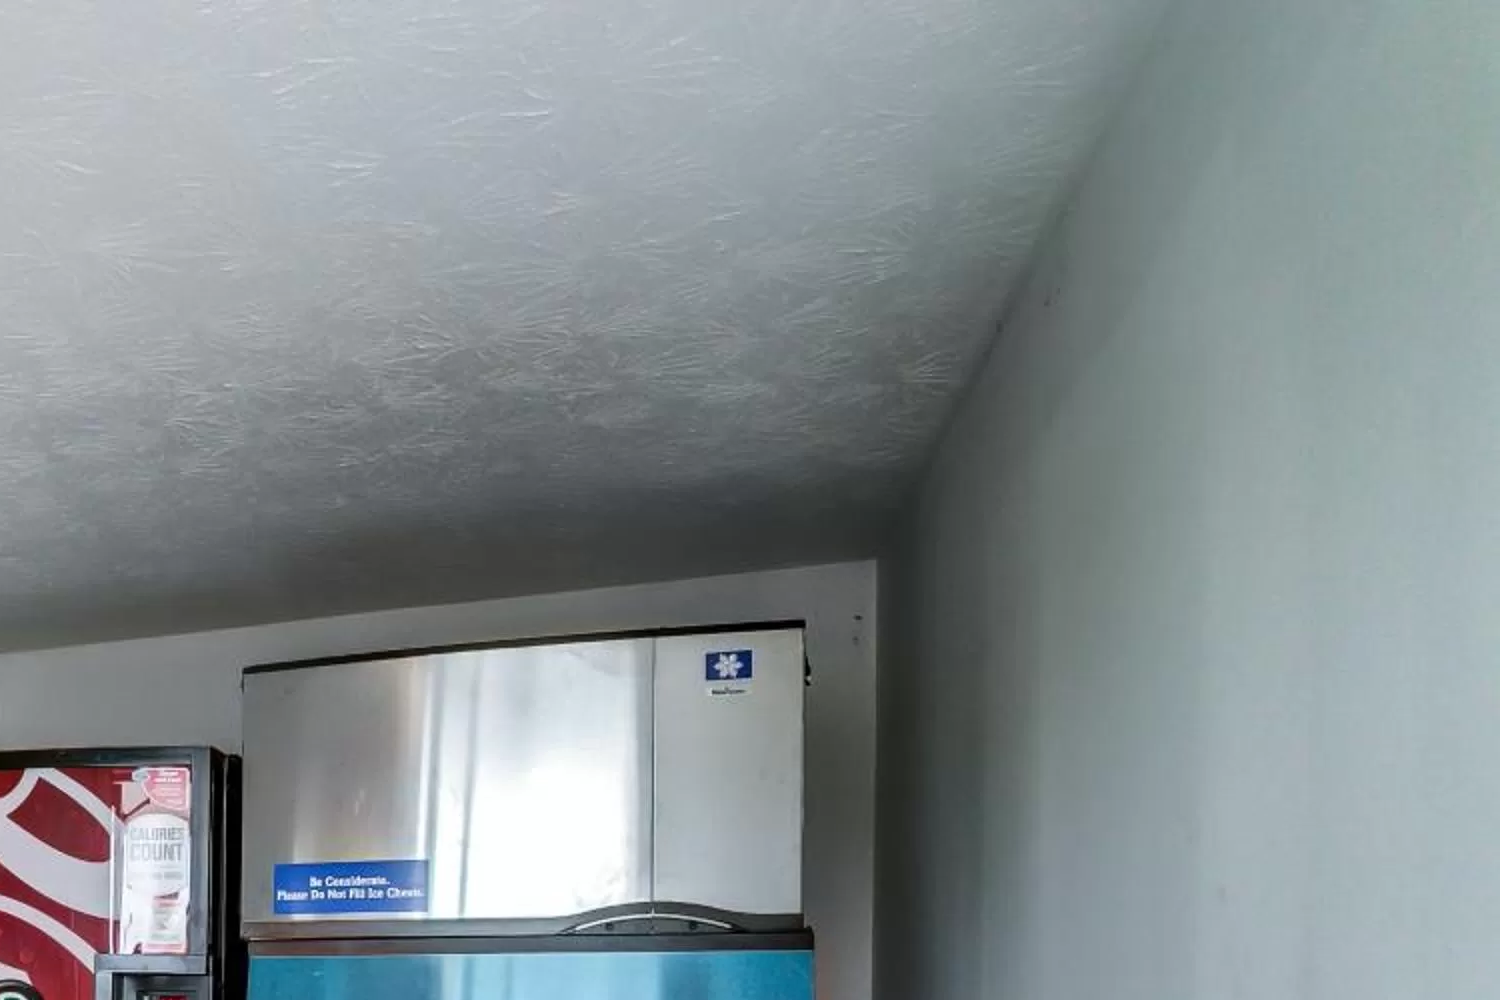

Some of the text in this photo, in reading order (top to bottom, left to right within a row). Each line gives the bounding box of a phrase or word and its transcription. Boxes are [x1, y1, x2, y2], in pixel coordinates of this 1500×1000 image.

[130, 842, 183, 862] COUNT
[311, 889, 325, 900] Do
[327, 888, 347, 899] Not
[368, 887, 384, 899] Ice
